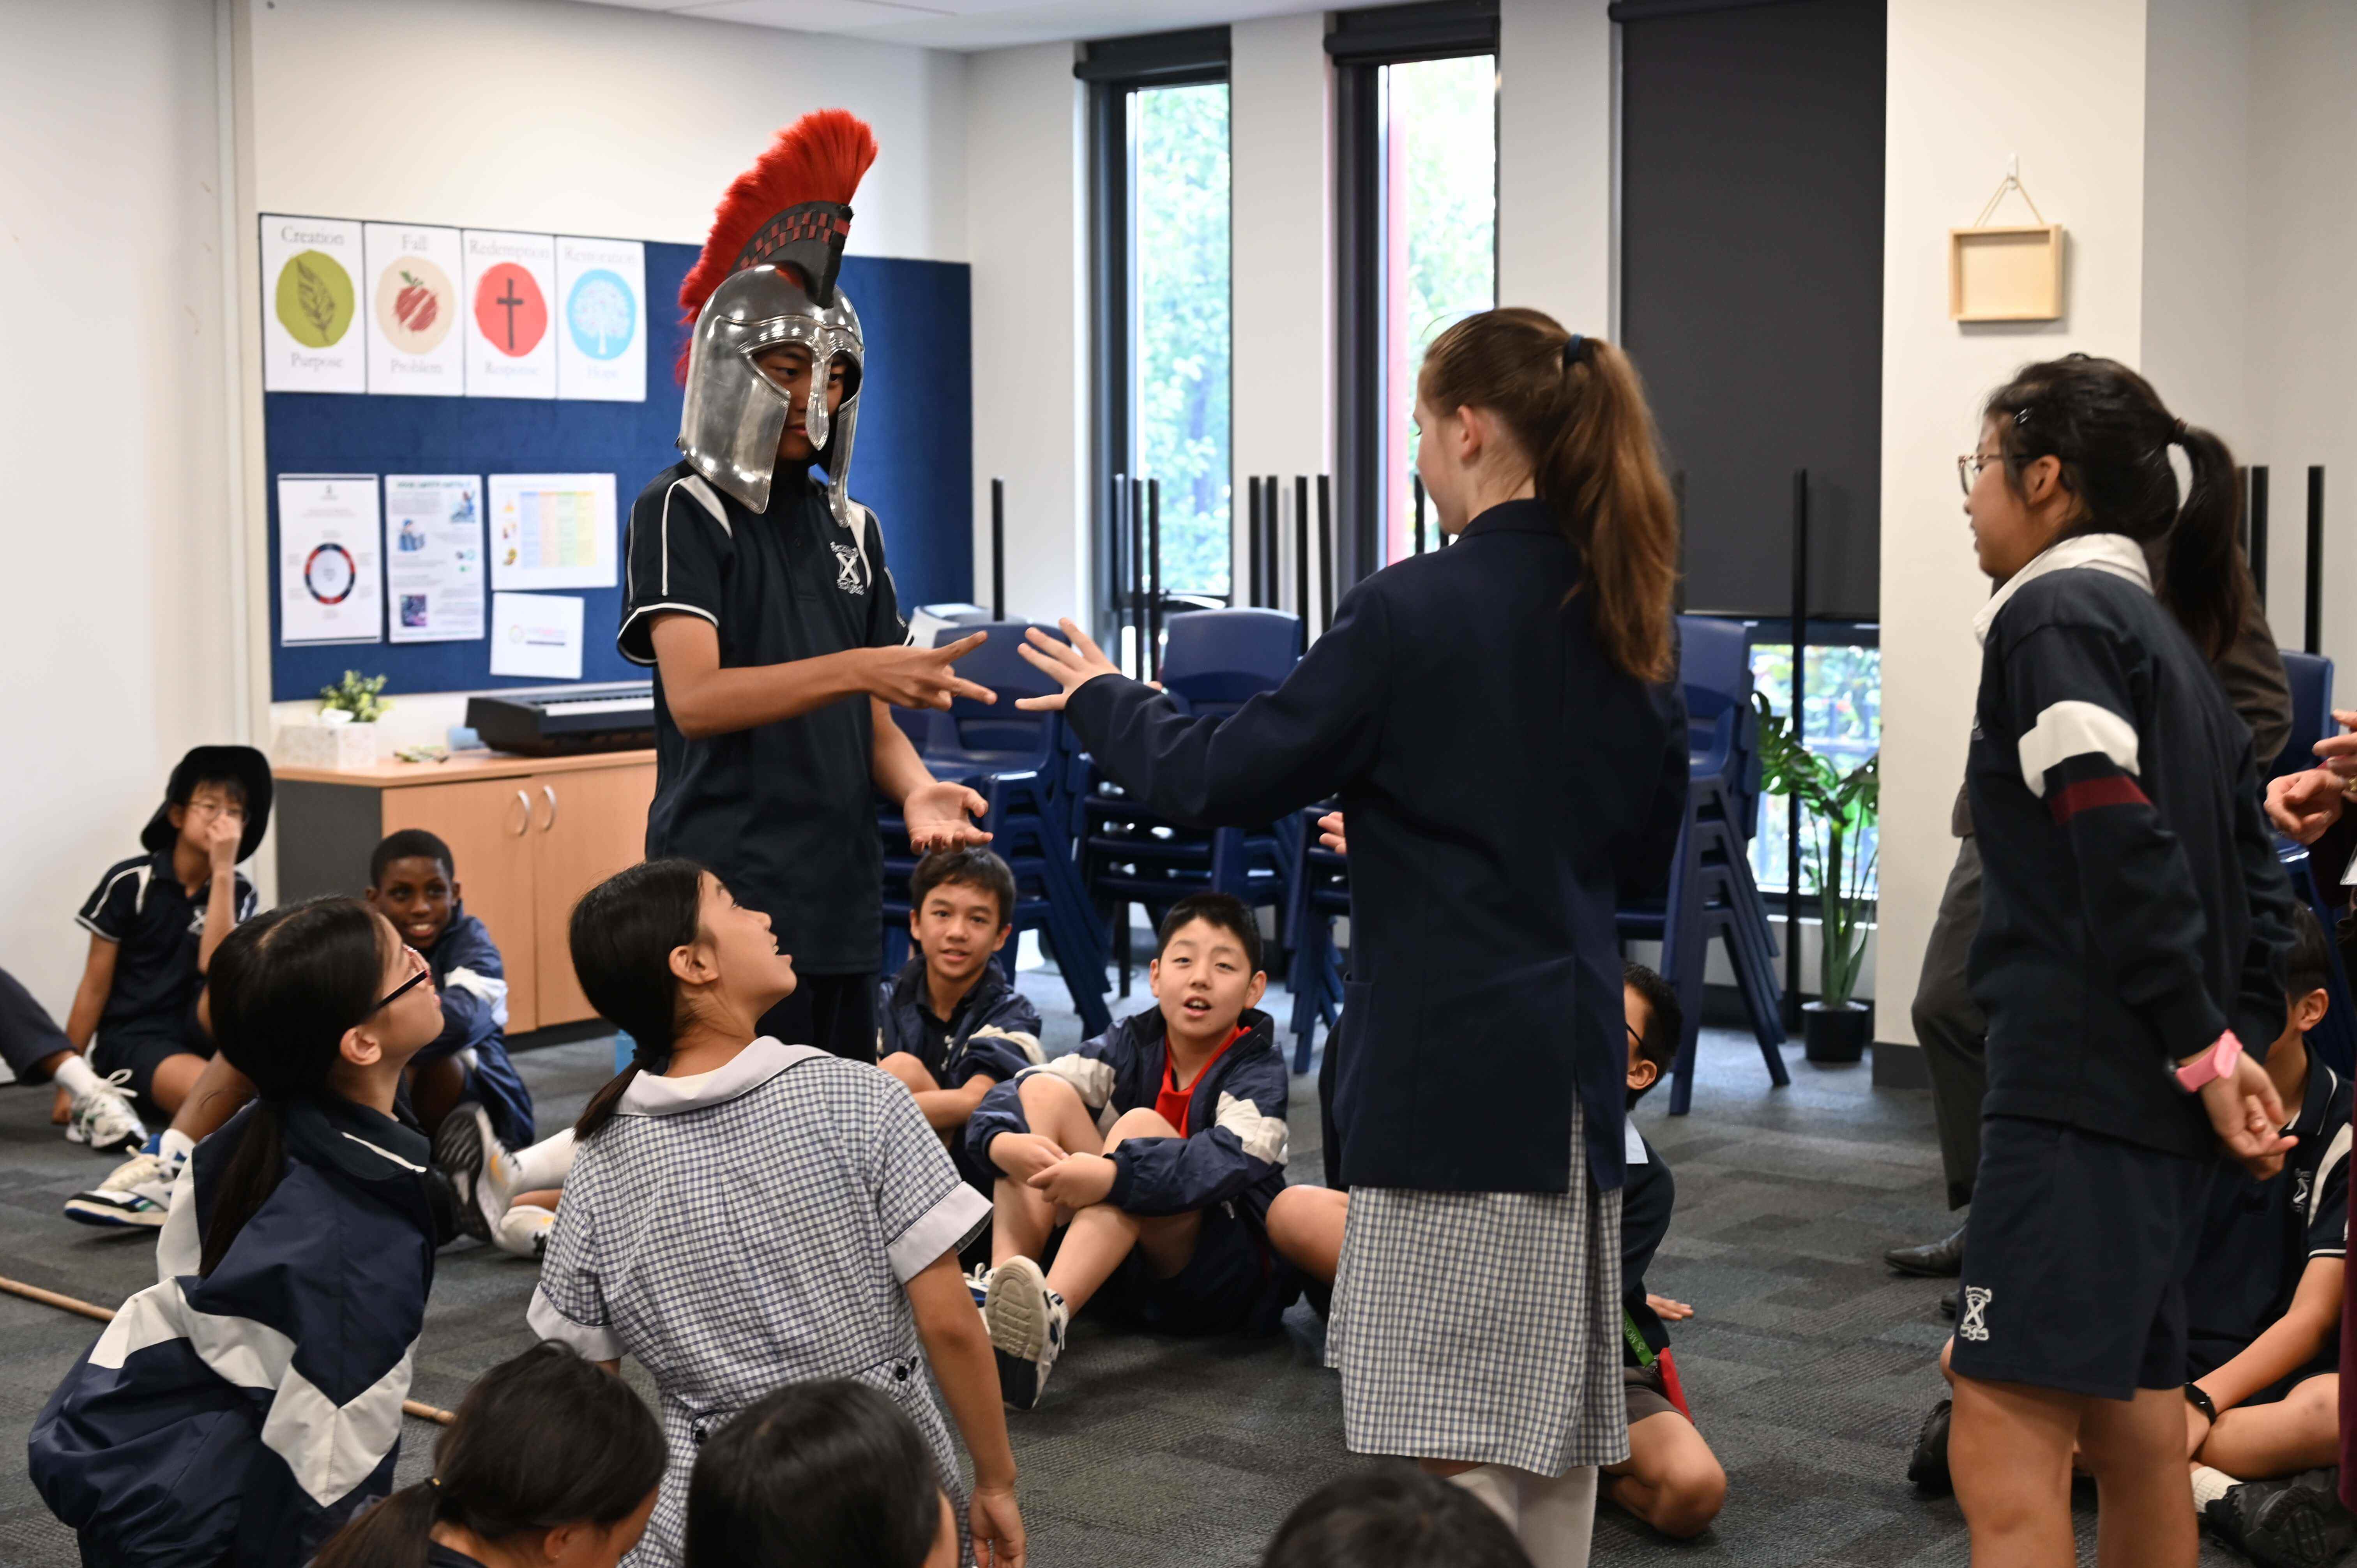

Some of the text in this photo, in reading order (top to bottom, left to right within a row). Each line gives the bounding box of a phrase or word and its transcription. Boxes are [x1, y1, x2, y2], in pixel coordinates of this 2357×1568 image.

[281, 225, 345, 246] Creation
[402, 233, 428, 251] Fall
[469, 239, 549, 262] Redemption
[292, 352, 344, 373] Purpose
[390, 358, 443, 374] Problem
[1624, 1322, 1638, 1344] MON
